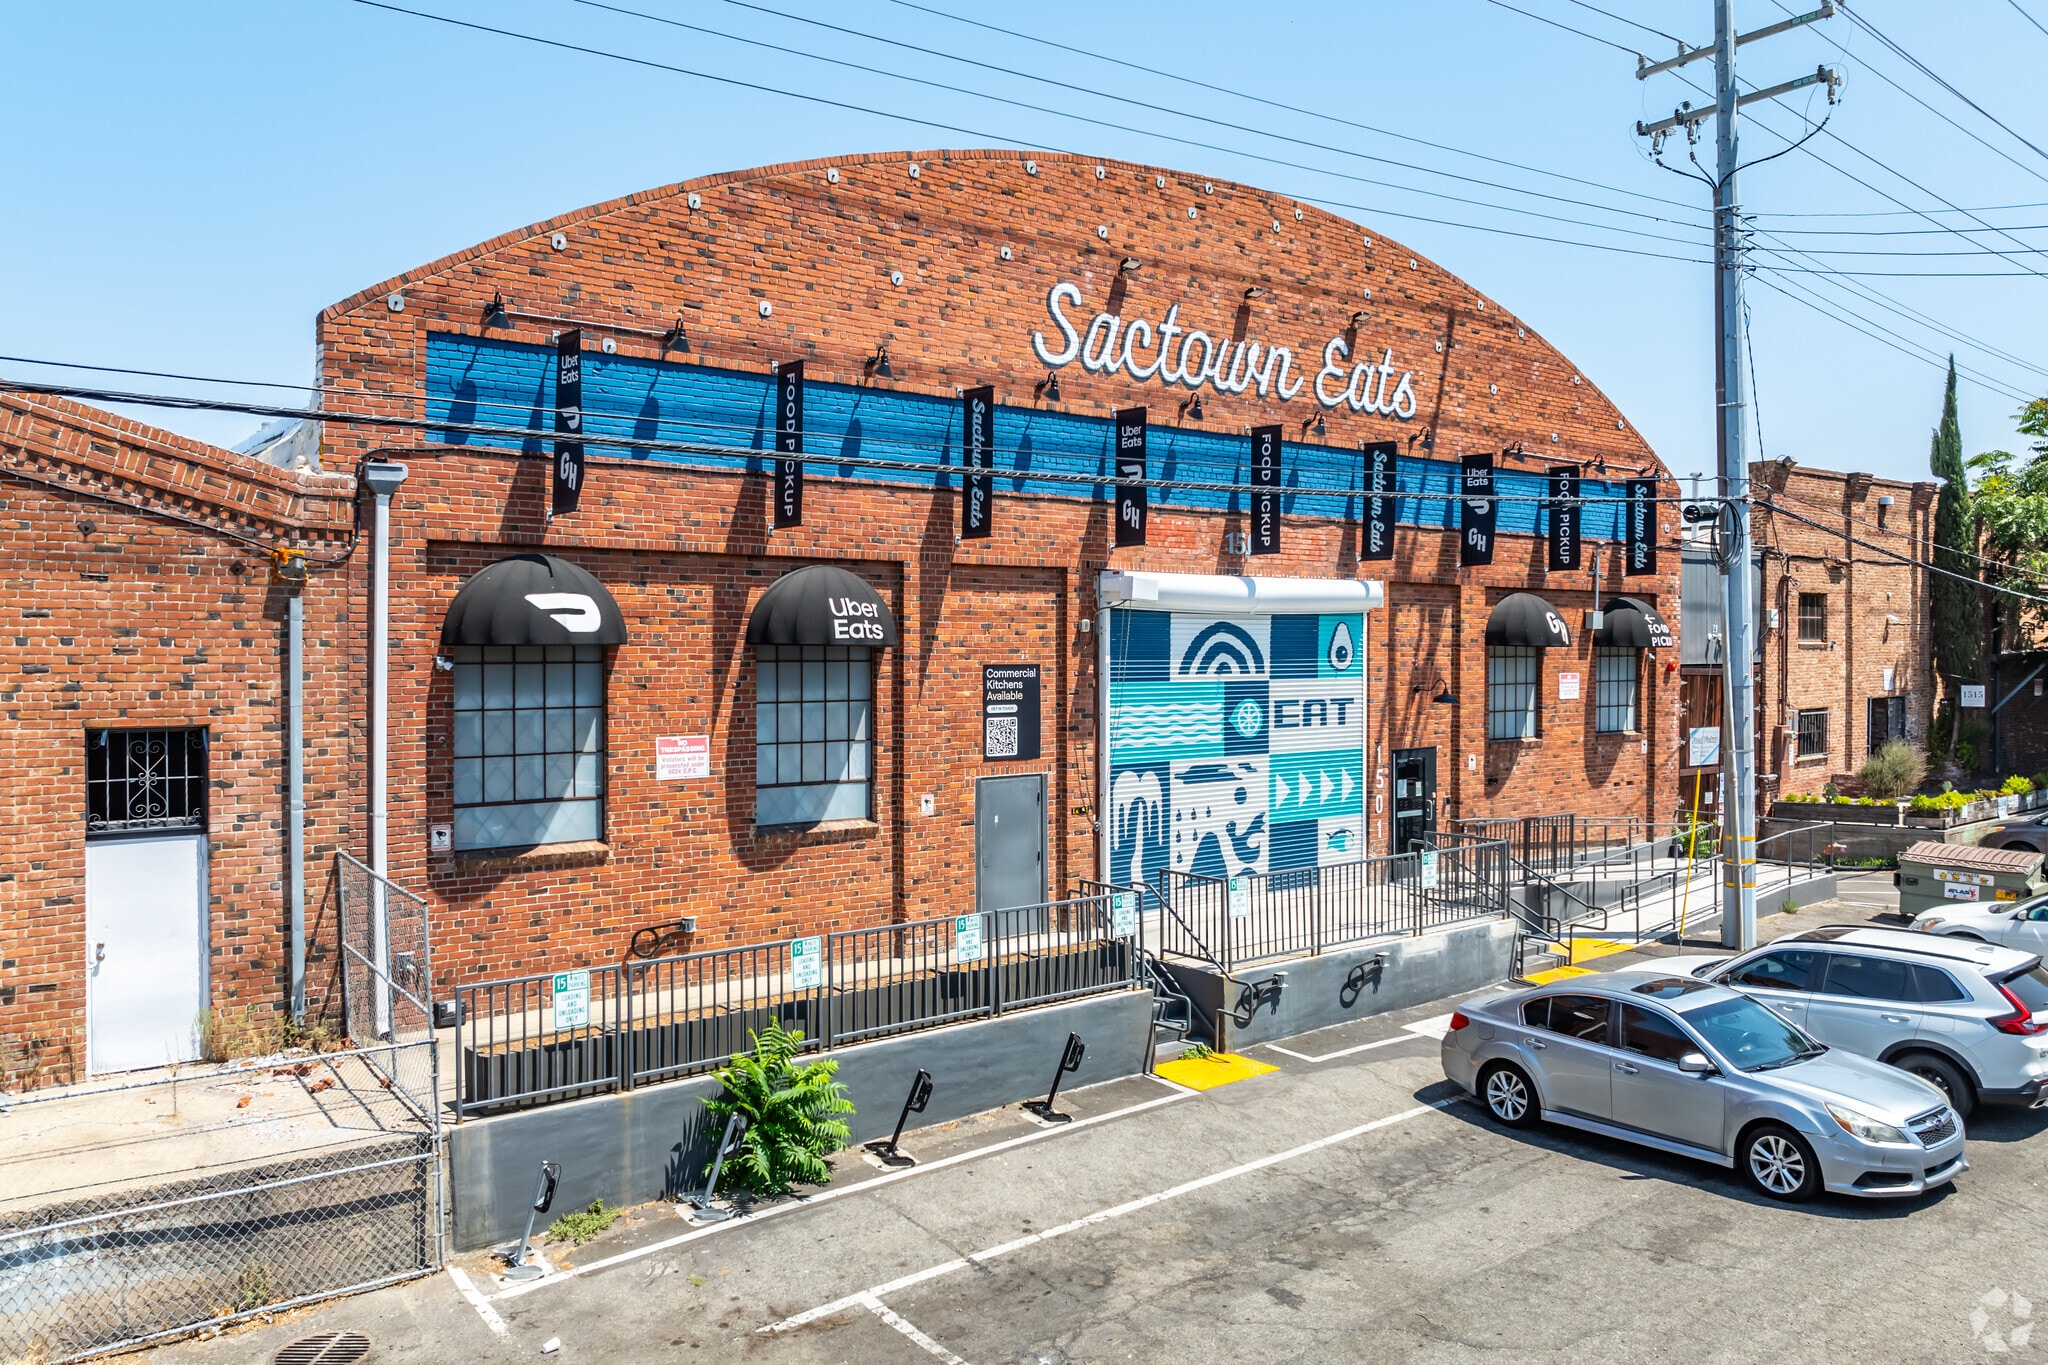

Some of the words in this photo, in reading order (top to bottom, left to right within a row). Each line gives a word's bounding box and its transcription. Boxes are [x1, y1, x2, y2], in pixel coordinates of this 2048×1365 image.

[1031, 281, 1304, 400] Sactown
[1313, 336, 1418, 420] Eats
[561, 354, 579, 370] Uber
[561, 369, 579, 385] Eats
[785, 373, 796, 432] FOOD
[1121, 425, 1142, 437] Uber
[1121, 436, 1142, 449] Eats
[1261, 433, 1272, 481] FOOD
[784, 439, 795, 517] PCKUP
[1466, 468, 1488, 478] Uber
[1466, 477, 1489, 487] Eats
[970, 486, 984, 529] Eats
[1261, 486, 1271, 547] ICKUP
[1225, 530, 1252, 556] 15
[1370, 519, 1385, 553] Eats
[1560, 514, 1570, 564] PICKUP
[1634, 541, 1648, 569] Eats
[828, 597, 879, 618] Uber
[833, 618, 884, 640] Eats
[986, 668, 1036, 678] Commercial
[986, 679, 1023, 690] Kitchens
[986, 690, 1024, 701] Available
[1963, 690, 1984, 699] 1515
[1274, 697, 1355, 729] EAT
[1376, 745, 1385, 839] 1501
[1116, 897, 1121, 907] 15
[958, 920, 965, 930] 15
[794, 943, 802, 955] 15
[557, 978, 566, 990] 15
[561, 993, 581, 1001] LOADING
[558, 1006, 585, 1016] UNLOADING
[565, 1015, 578, 1023] ONLY
